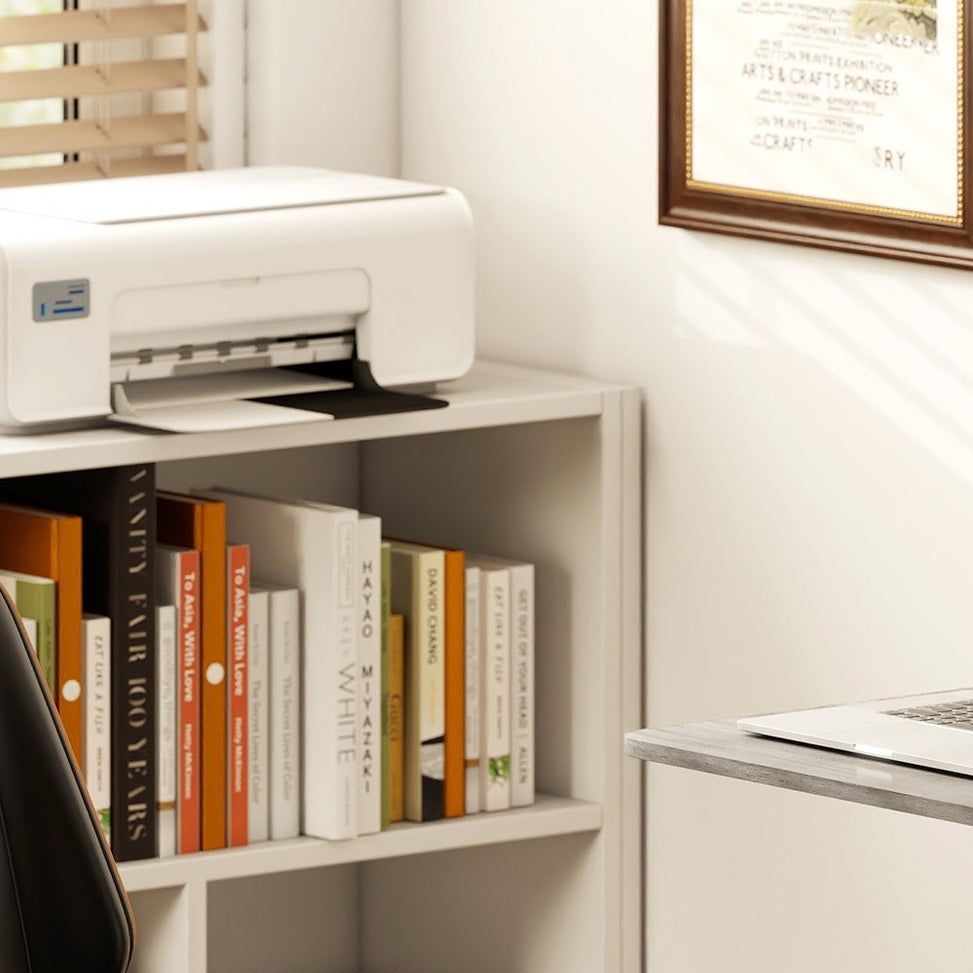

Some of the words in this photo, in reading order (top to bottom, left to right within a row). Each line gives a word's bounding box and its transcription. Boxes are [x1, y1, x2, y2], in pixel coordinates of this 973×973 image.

[799, 51, 834, 66] PRINTS
[741, 63, 774, 81] ARTS
[778, 66, 786, 82] &
[790, 68, 840, 89] CRAFTS
[844, 75, 900, 96] PIONEER
[128, 469, 147, 577] VANITY
[184, 572, 195, 591] To
[234, 565, 245, 585] To
[428, 567, 438, 611] DAVID
[183, 594, 196, 629] Asia,
[233, 588, 245, 622] Asia,
[363, 561, 374, 639] HAYAO
[519, 589, 528, 612] GET
[128, 593, 147, 662] FAIR
[234, 625, 245, 660] With
[428, 615, 438, 665] CHANG
[519, 615, 528, 639] OUT
[184, 631, 195, 665] With
[519, 642, 528, 656] OF
[184, 668, 195, 703] Love
[234, 663, 245, 697] Love
[519, 662, 528, 691] YOUR
[128, 677, 147, 728] 100
[337, 663, 356, 765] WHITE
[390, 694, 402, 741] Gucci
[363, 666, 373, 794] MIYAZAKI
[519, 745, 528, 785] ALLEN
[128, 738, 147, 841] YEARS
